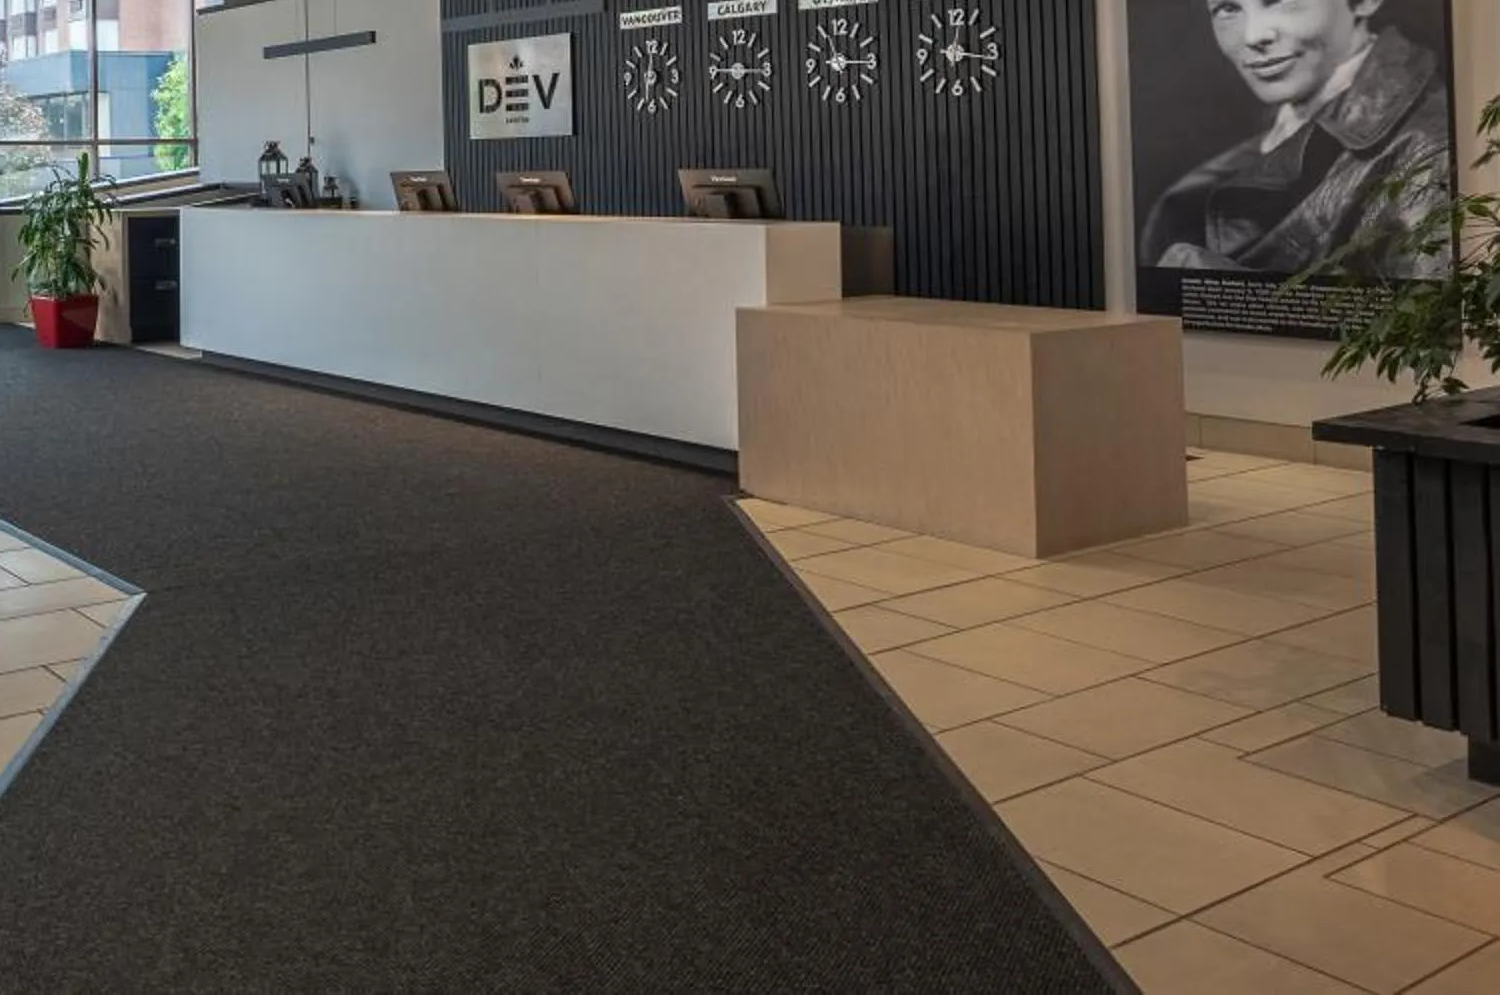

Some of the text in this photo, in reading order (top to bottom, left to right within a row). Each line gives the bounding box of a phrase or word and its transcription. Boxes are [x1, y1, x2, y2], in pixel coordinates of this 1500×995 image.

[717, 0, 767, 15] CALGARY
[621, 10, 679, 26] VANCOUVER
[948, 8, 965, 26] 12
[832, 18, 848, 36] 12
[732, 29, 746, 45] 12
[916, 48, 928, 65] 9
[987, 42, 999, 60] 3
[805, 59, 816, 74] 9
[867, 53, 876, 69] 3
[671, 68, 679, 84] 3
[708, 65, 718, 80] 9
[763, 62, 771, 77] 3
[478, 72, 560, 114] DEV
[835, 87, 845, 103] 6
[952, 79, 963, 96] 6
[647, 99, 657, 113] 6
[735, 93, 745, 108] 6
